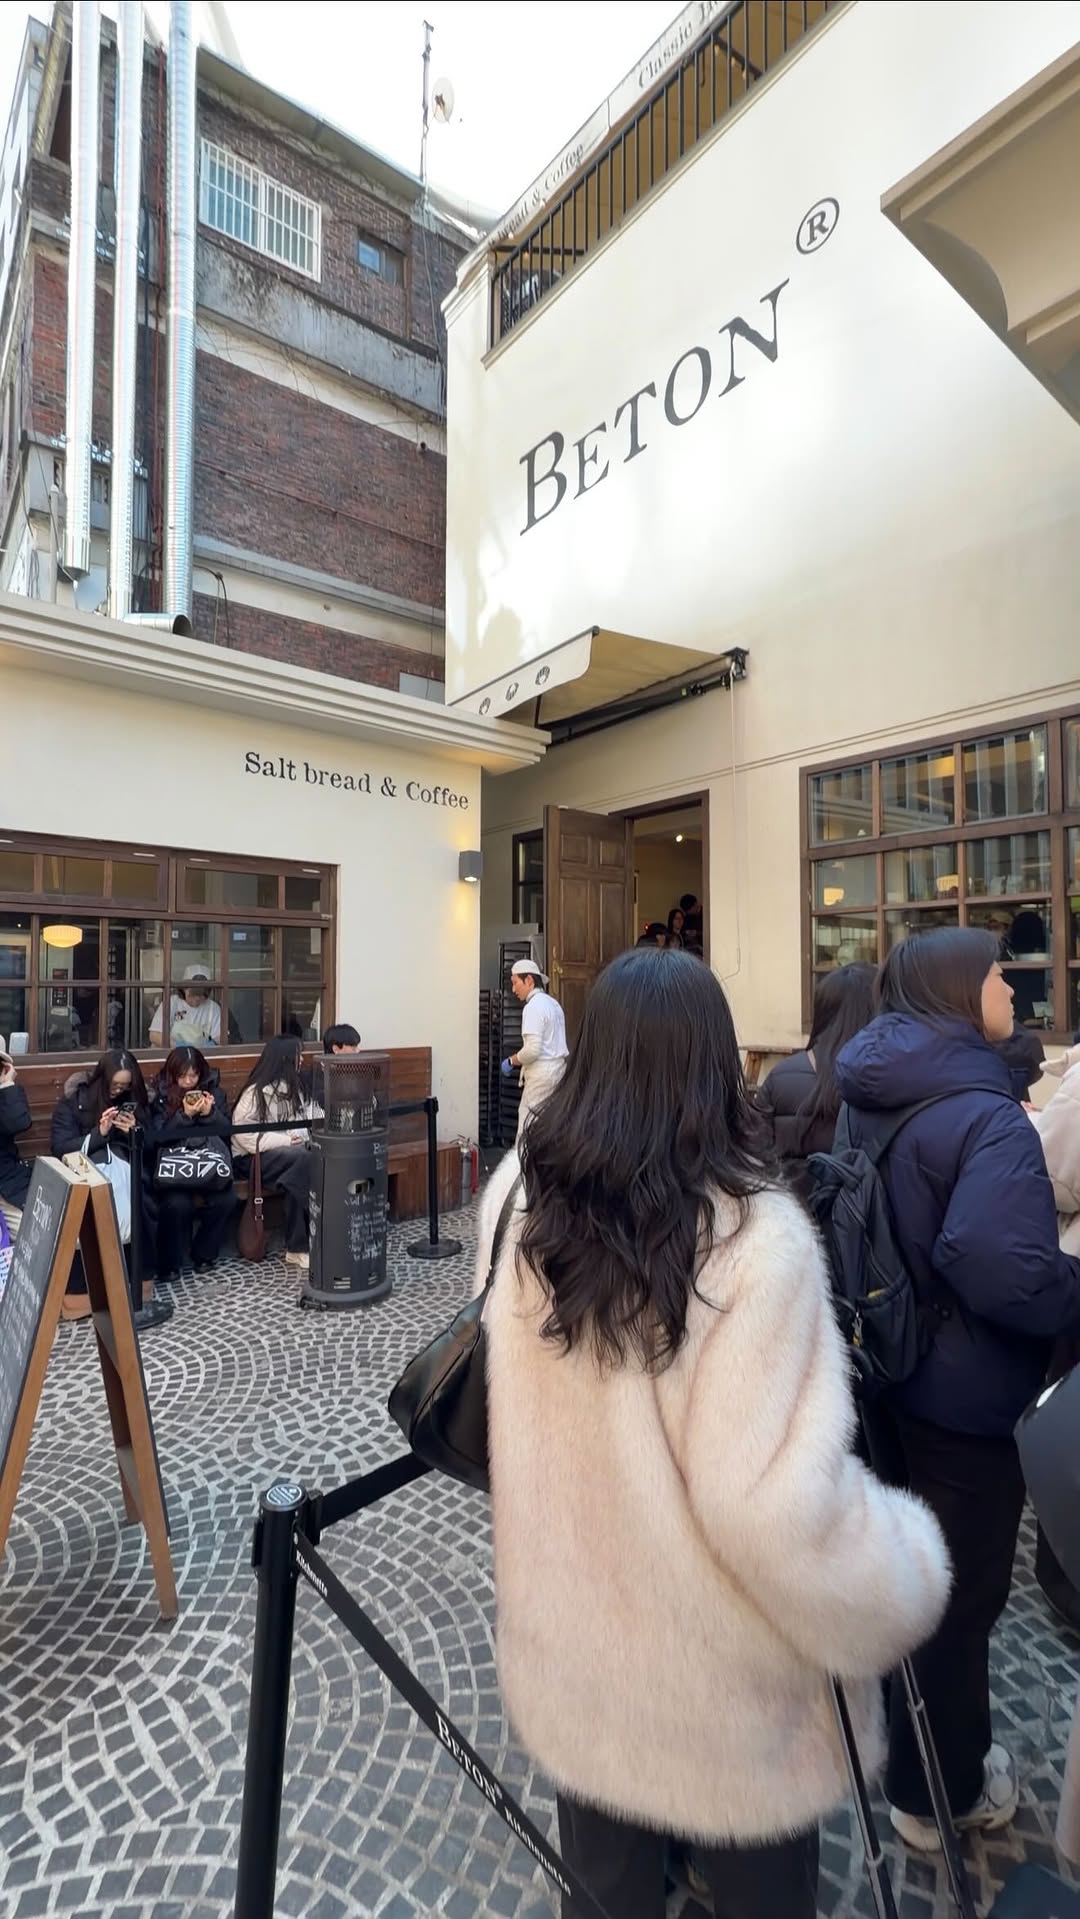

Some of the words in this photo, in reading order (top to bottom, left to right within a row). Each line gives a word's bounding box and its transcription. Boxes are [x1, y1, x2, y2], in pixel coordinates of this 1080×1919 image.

[519, 277, 790, 537] BETON
[244, 751, 297, 782] Salt
[303, 762, 372, 795] bread
[380, 775, 398, 798] &
[405, 780, 470, 811] Coffee
